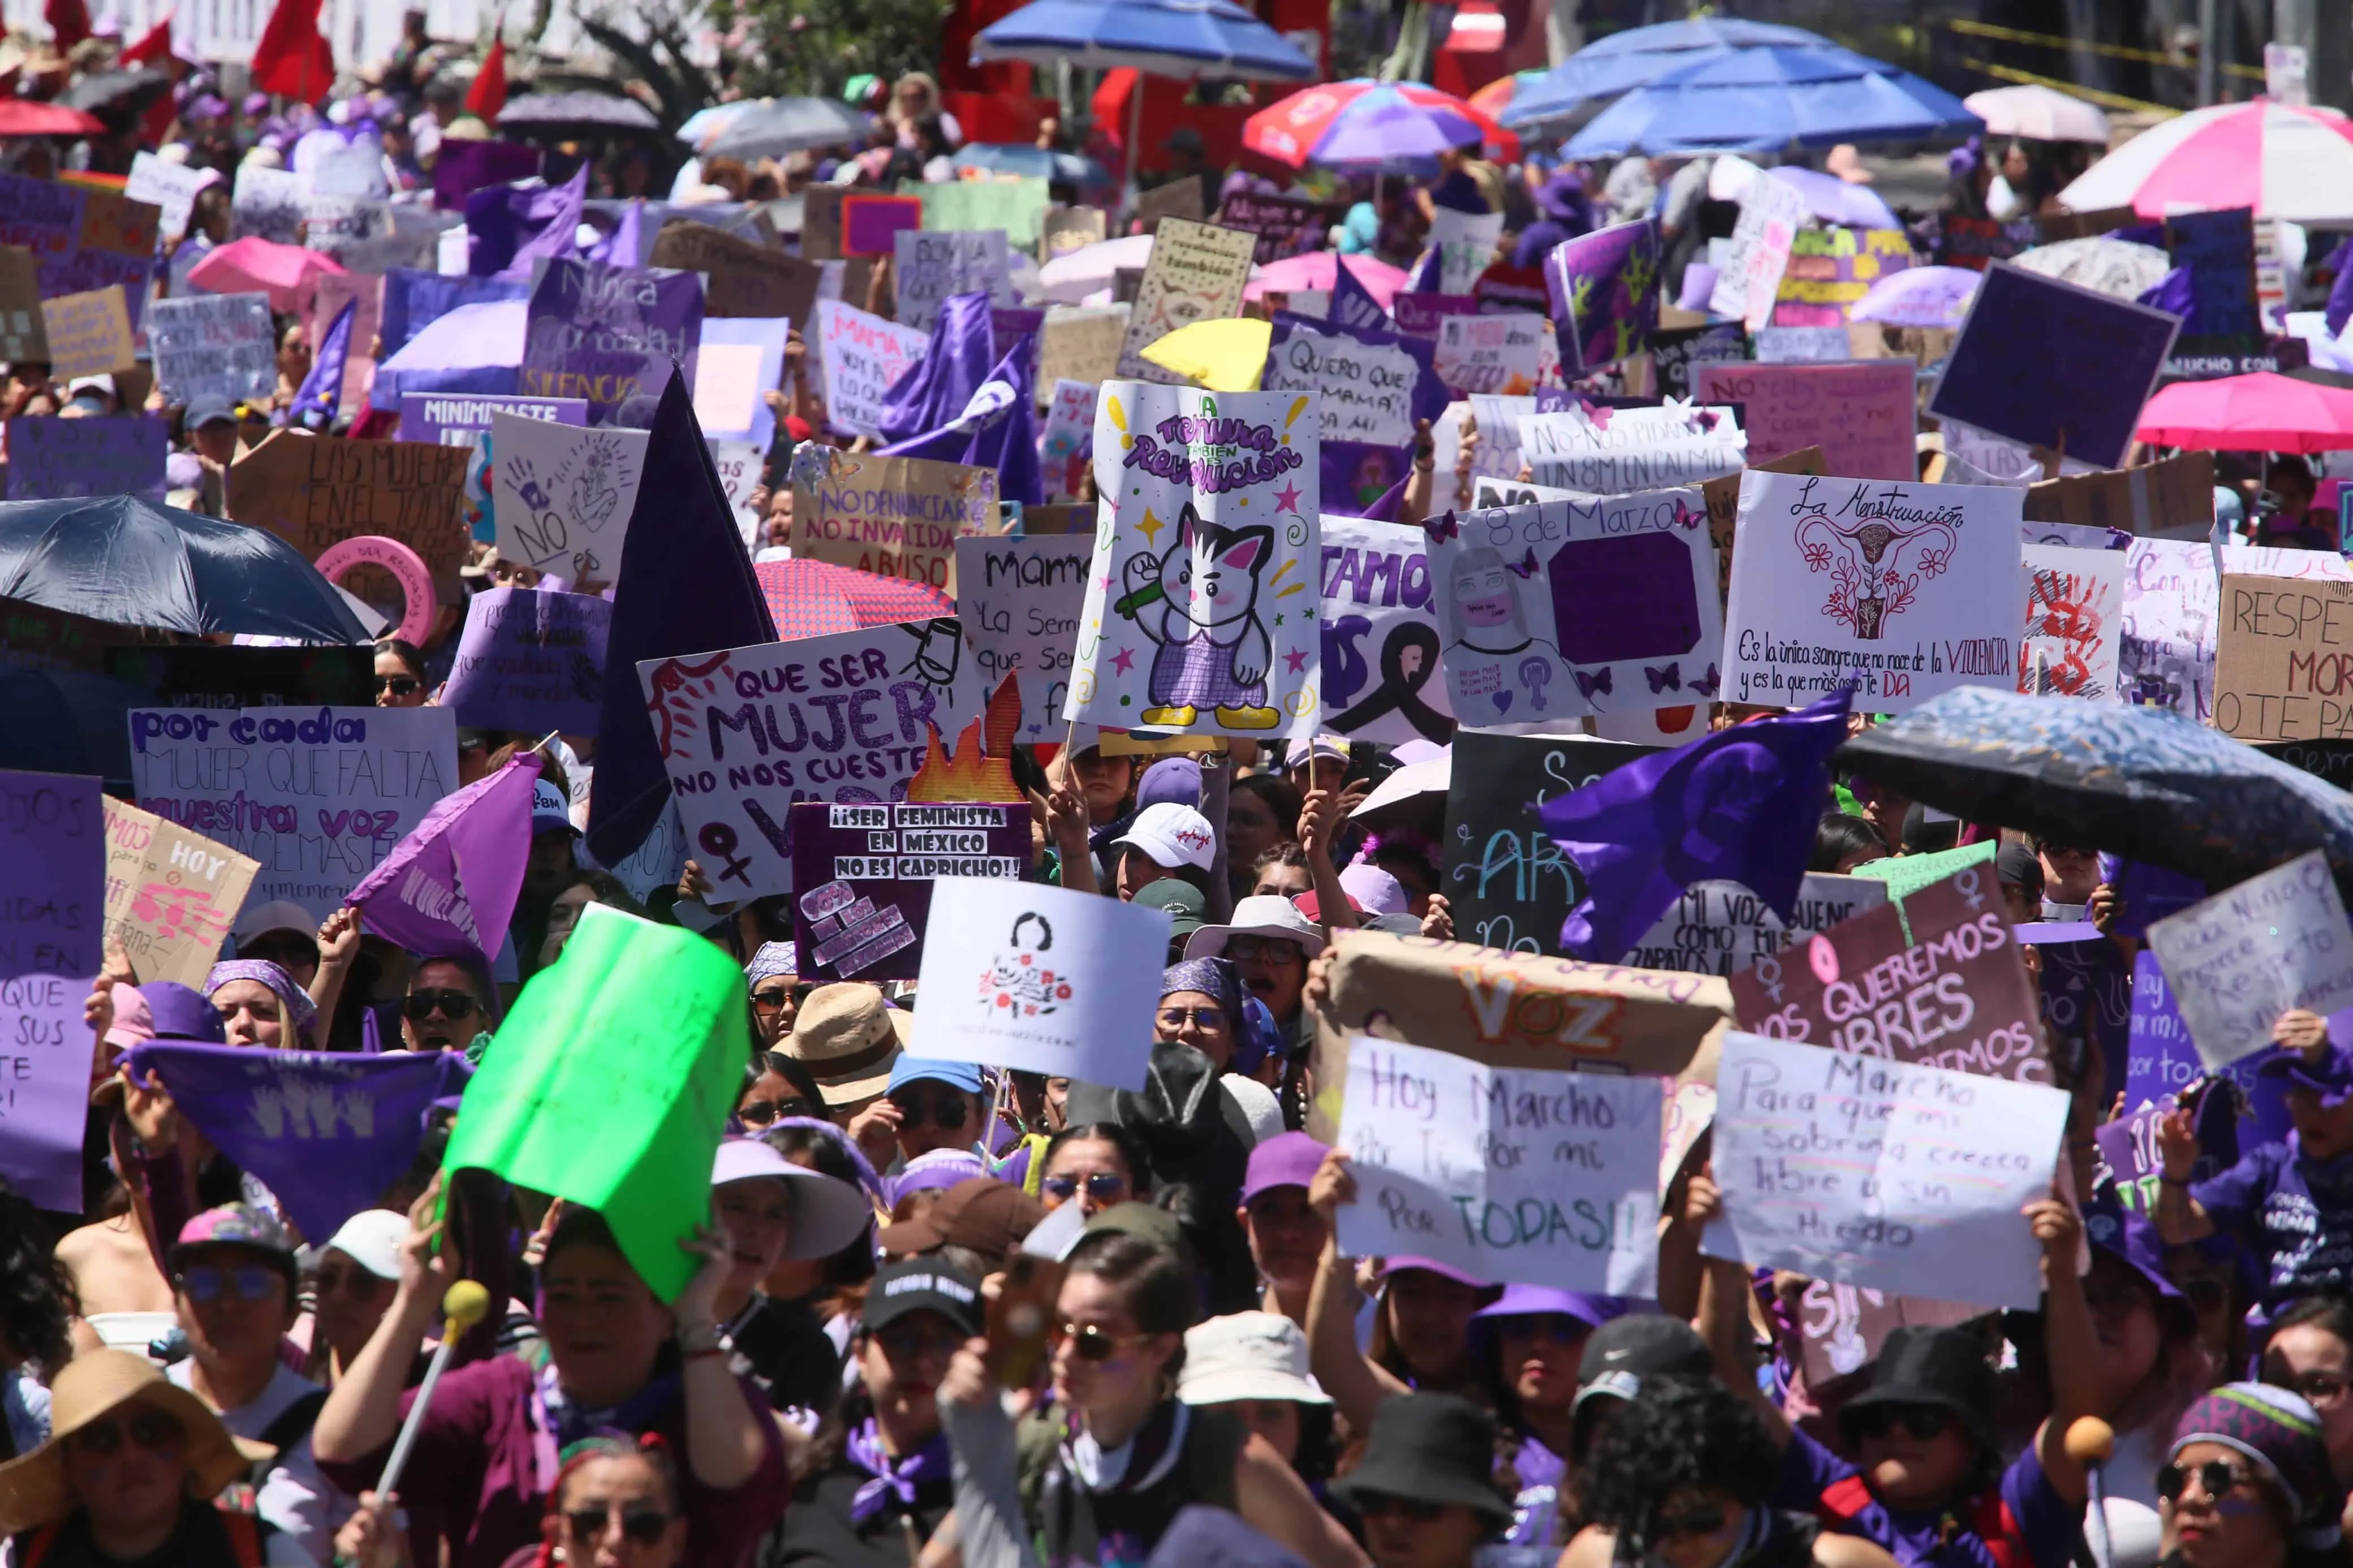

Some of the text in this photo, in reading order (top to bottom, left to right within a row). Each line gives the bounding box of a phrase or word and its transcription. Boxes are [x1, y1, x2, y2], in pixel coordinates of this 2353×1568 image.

[1288, 339, 1408, 389] QUIERO QUE
[2240, 356, 2278, 372] CON
[1202, 395, 1218, 417] A
[820, 489, 968, 523] NO DENUNCIAR
[1485, 498, 1675, 546] 8 de Marzo
[1790, 476, 1964, 529] La Menstruación
[514, 511, 567, 565] NO
[806, 518, 955, 550] NO INVALIDA
[857, 550, 949, 590] ABUSO
[1321, 545, 1437, 615] TAMO
[980, 600, 1010, 633] La
[2234, 589, 2353, 645] RESPE
[736, 648, 890, 699] QUE SER
[977, 650, 1025, 680] que
[1738, 629, 1761, 662] Es
[1765, 630, 1777, 663] la
[1812, 646, 1851, 677] sangre
[1851, 650, 1869, 672] que
[1872, 654, 1883, 669] no
[1887, 654, 1910, 671] nace
[1912, 642, 1925, 672] de
[1931, 642, 1941, 674] la
[1946, 638, 2010, 677] VIOLENCIA
[1738, 671, 1751, 702] y
[1753, 672, 1768, 688] es
[1772, 664, 1783, 689] la
[1787, 676, 1807, 705] que
[1862, 667, 1877, 697] te
[1882, 670, 1910, 698] DA
[131, 706, 367, 753] por cada
[706, 680, 943, 762] MUJER
[2216, 692, 2242, 733] O
[2246, 693, 2309, 740] TE
[144, 747, 446, 800] MUJER QUE FALTA
[673, 746, 928, 797] NO NOS CUESTE
[317, 809, 401, 841] voz
[540, 797, 561, 810] 8M
[897, 806, 1004, 826] FEMINISTA
[169, 839, 227, 883] HOY
[869, 829, 985, 852] EN MÉXICO
[274, 880, 356, 898] memori
[835, 856, 1020, 879] NO ES CAPRICHO!!
[1679, 889, 1708, 922] MI
[1723, 892, 1766, 927] VOZ
[1673, 924, 1794, 952] COMO MIS
[1823, 912, 2006, 1021] QUEREMOS
[1, 979, 65, 1009] QUE
[1453, 964, 1625, 1045] VOZ
[1830, 973, 1976, 1059] IBRES
[14, 1014, 65, 1047] SUS
[1369, 1050, 1616, 1130] Hoy Marcho
[1731, 1056, 1816, 1112] Para
[1839, 1098, 1896, 1135] que
[1824, 1055, 1977, 1107] Marcho
